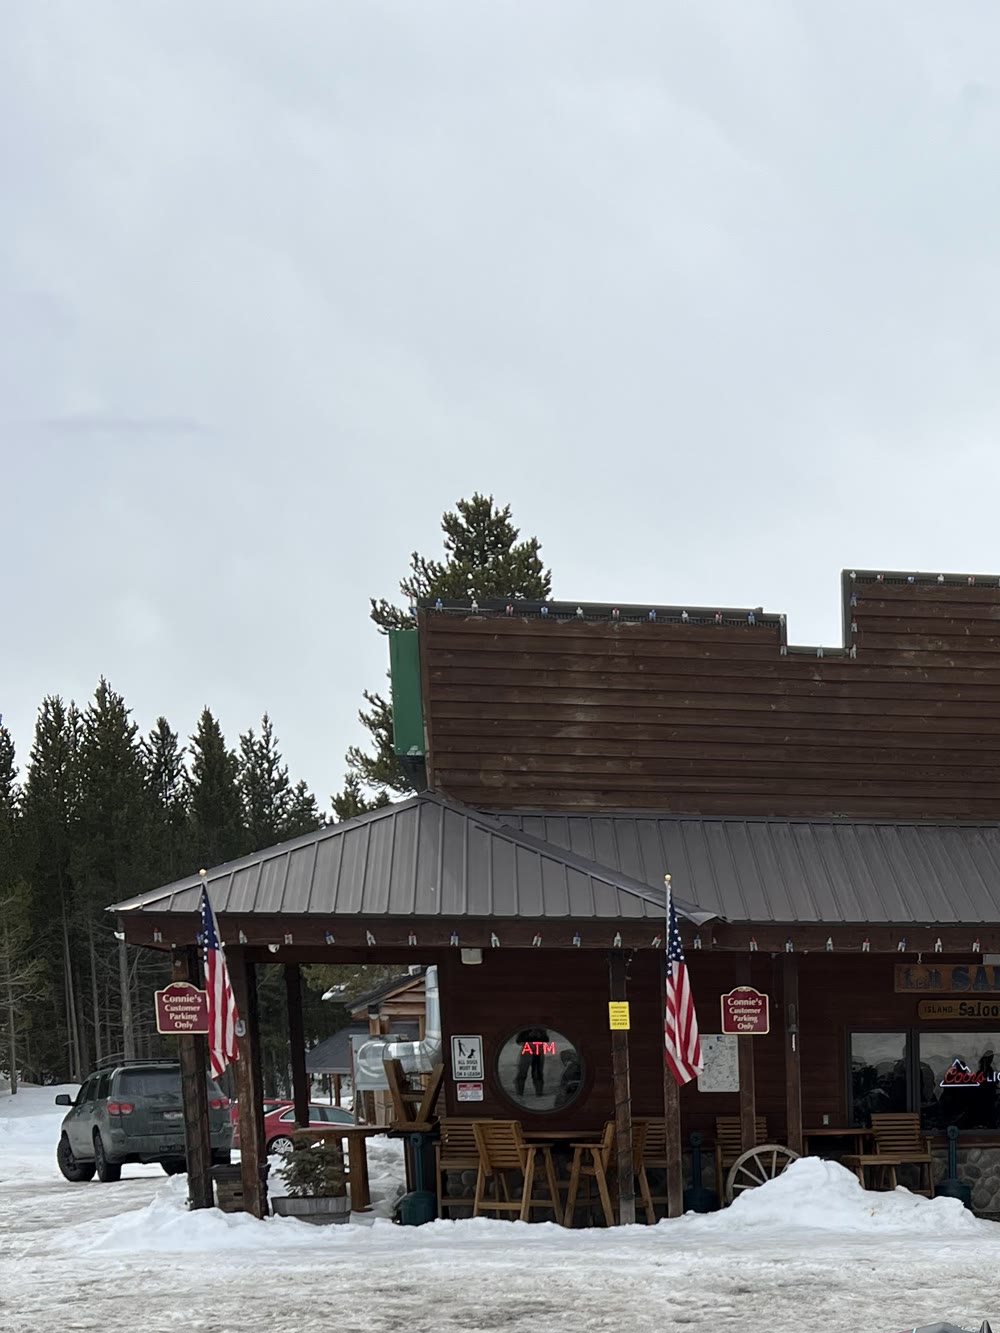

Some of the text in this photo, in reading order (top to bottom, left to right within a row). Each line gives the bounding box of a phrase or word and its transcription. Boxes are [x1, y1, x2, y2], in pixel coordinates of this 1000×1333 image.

[162, 994, 202, 1003] Connie's
[727, 997, 763, 1006] Connie's
[164, 1004, 201, 1012] Customer
[924, 1005, 953, 1014] ISLAND
[169, 1012, 198, 1022] Parking
[733, 1014, 758, 1024] Parking
[174, 1021, 194, 1030] Only
[737, 1022, 755, 1031] Only
[521, 1041, 556, 1056] ATM
[944, 1066, 987, 1084] Coors
